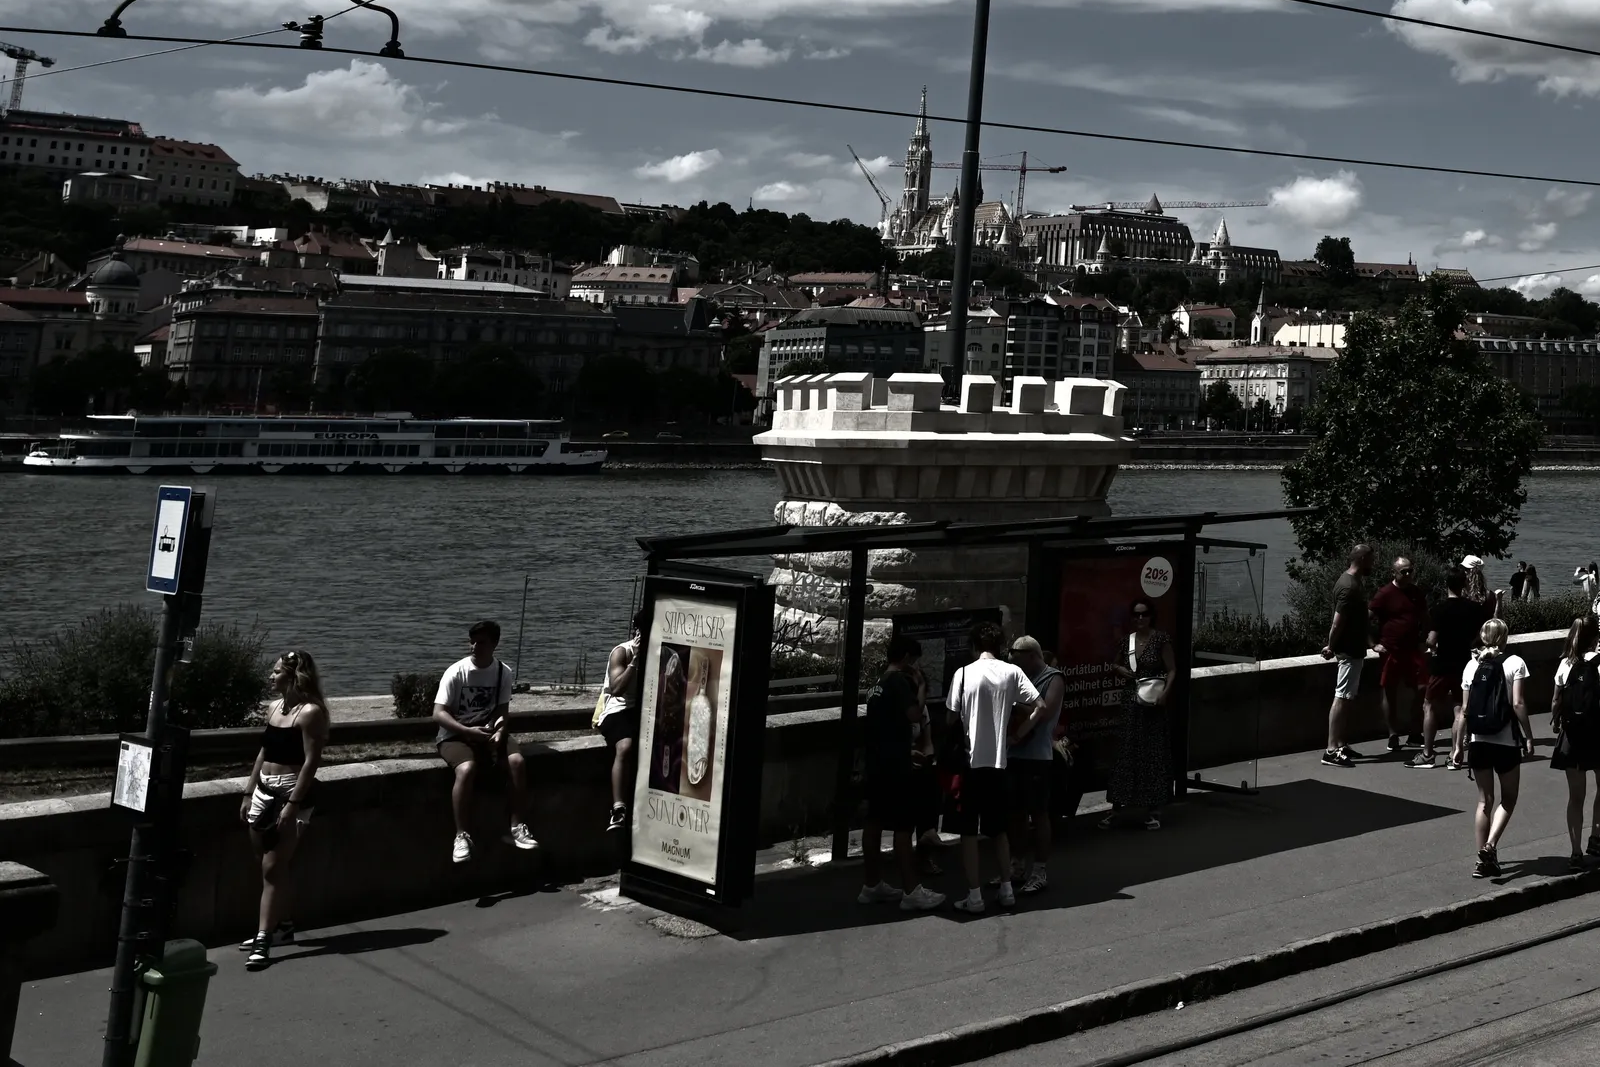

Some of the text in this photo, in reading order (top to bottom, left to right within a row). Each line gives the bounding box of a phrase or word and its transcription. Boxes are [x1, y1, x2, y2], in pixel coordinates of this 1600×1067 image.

[1144, 566, 1169, 582] 20%
[1102, 678, 1113, 691] és
[1062, 697, 1080, 709] sak
[1082, 693, 1102, 707] havi
[1103, 693, 1110, 703] 9
[661, 840, 691, 860] MAGNUM
